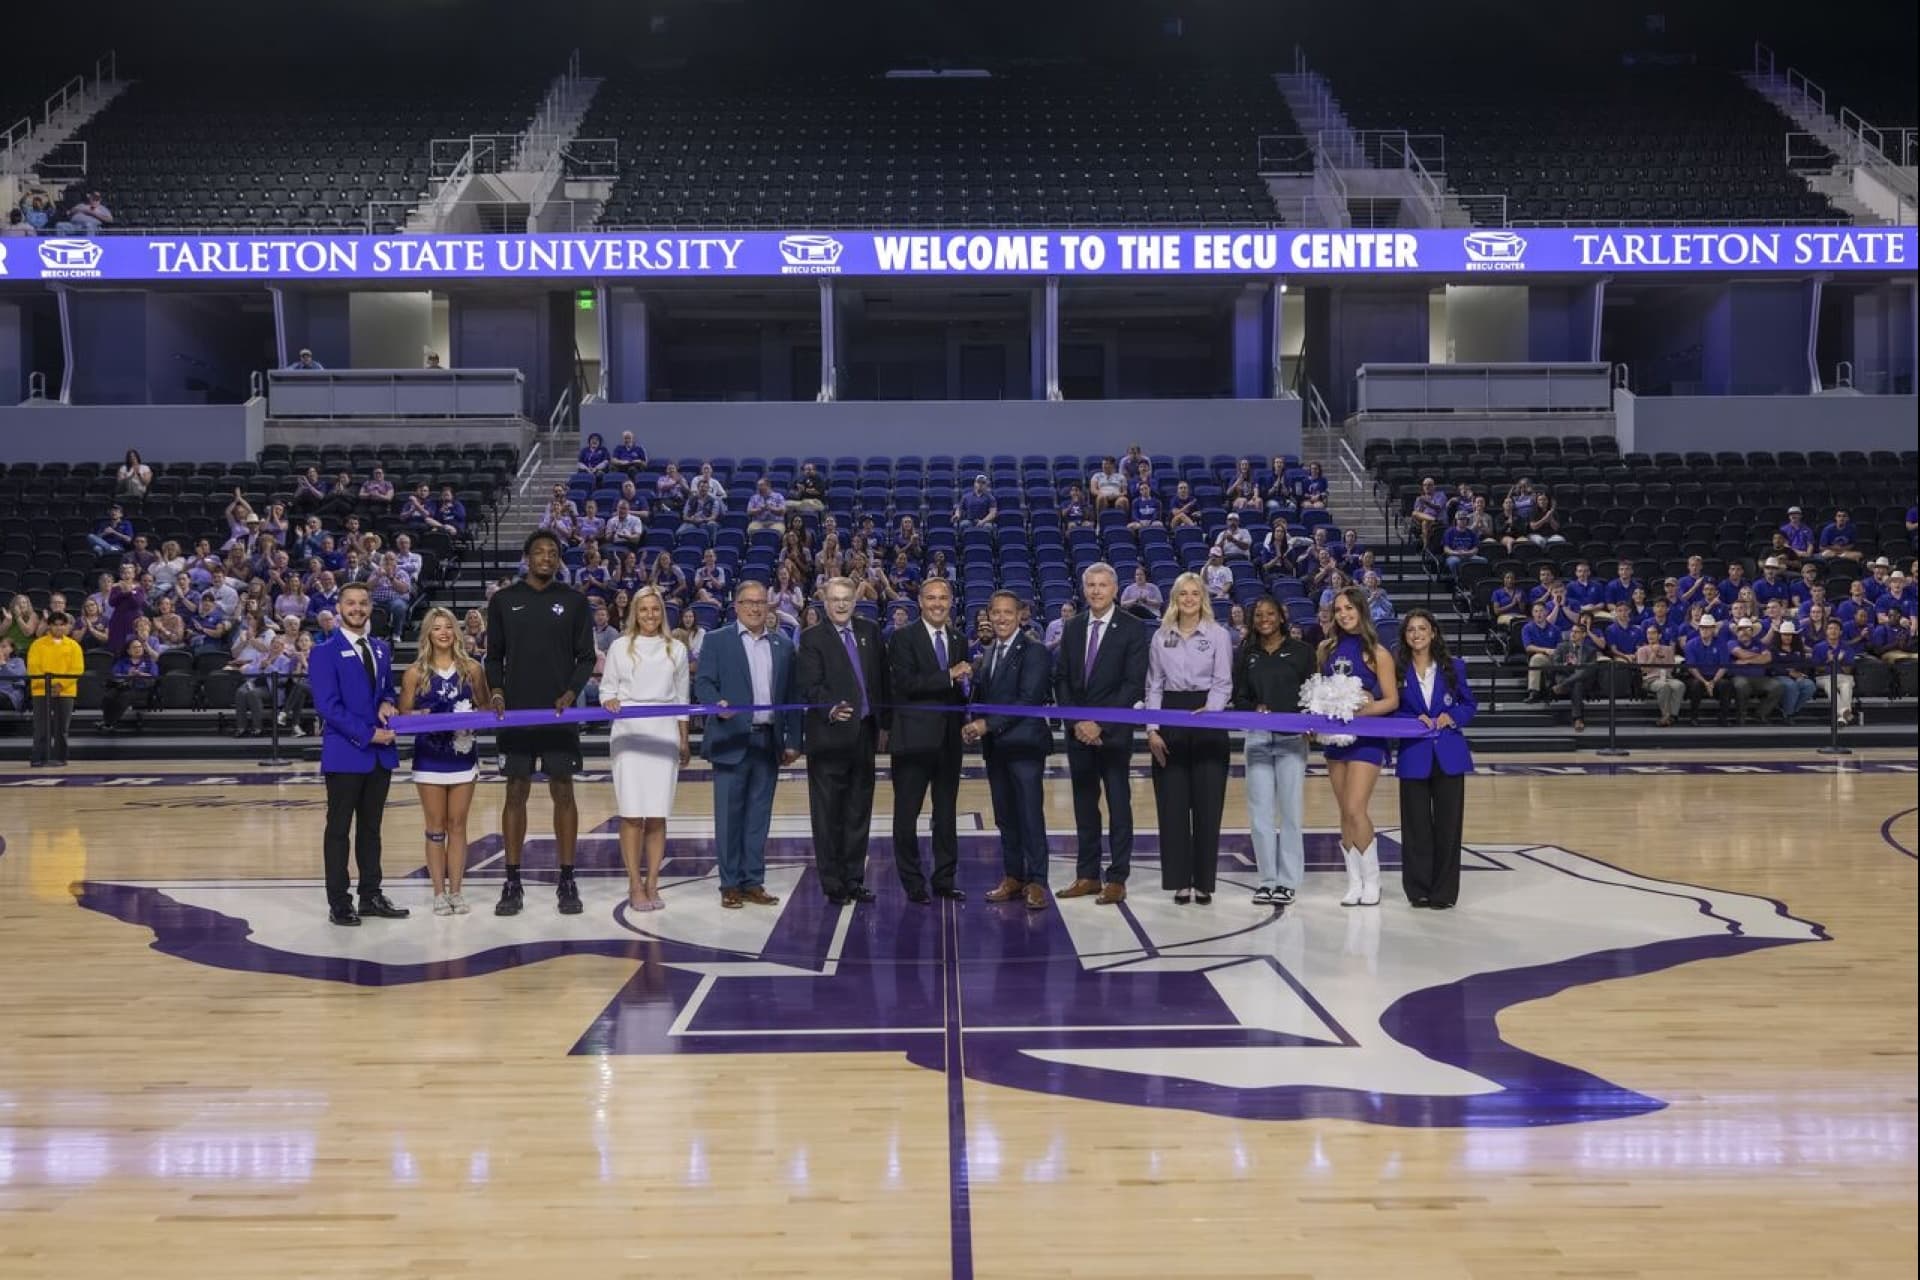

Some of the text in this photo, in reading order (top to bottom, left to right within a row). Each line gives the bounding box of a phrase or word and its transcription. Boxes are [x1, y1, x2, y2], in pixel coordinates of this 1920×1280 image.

[149, 238, 745, 273] TARLETON STATE UNIVERSITY
[874, 233, 1419, 271] WELCOME TO THE EECU CENTER
[1573, 232, 1905, 265] TARLETON STATE
[70, 270, 101, 278] CENTER
[810, 265, 842, 274] CENTER
[1494, 262, 1526, 271] CENTER
